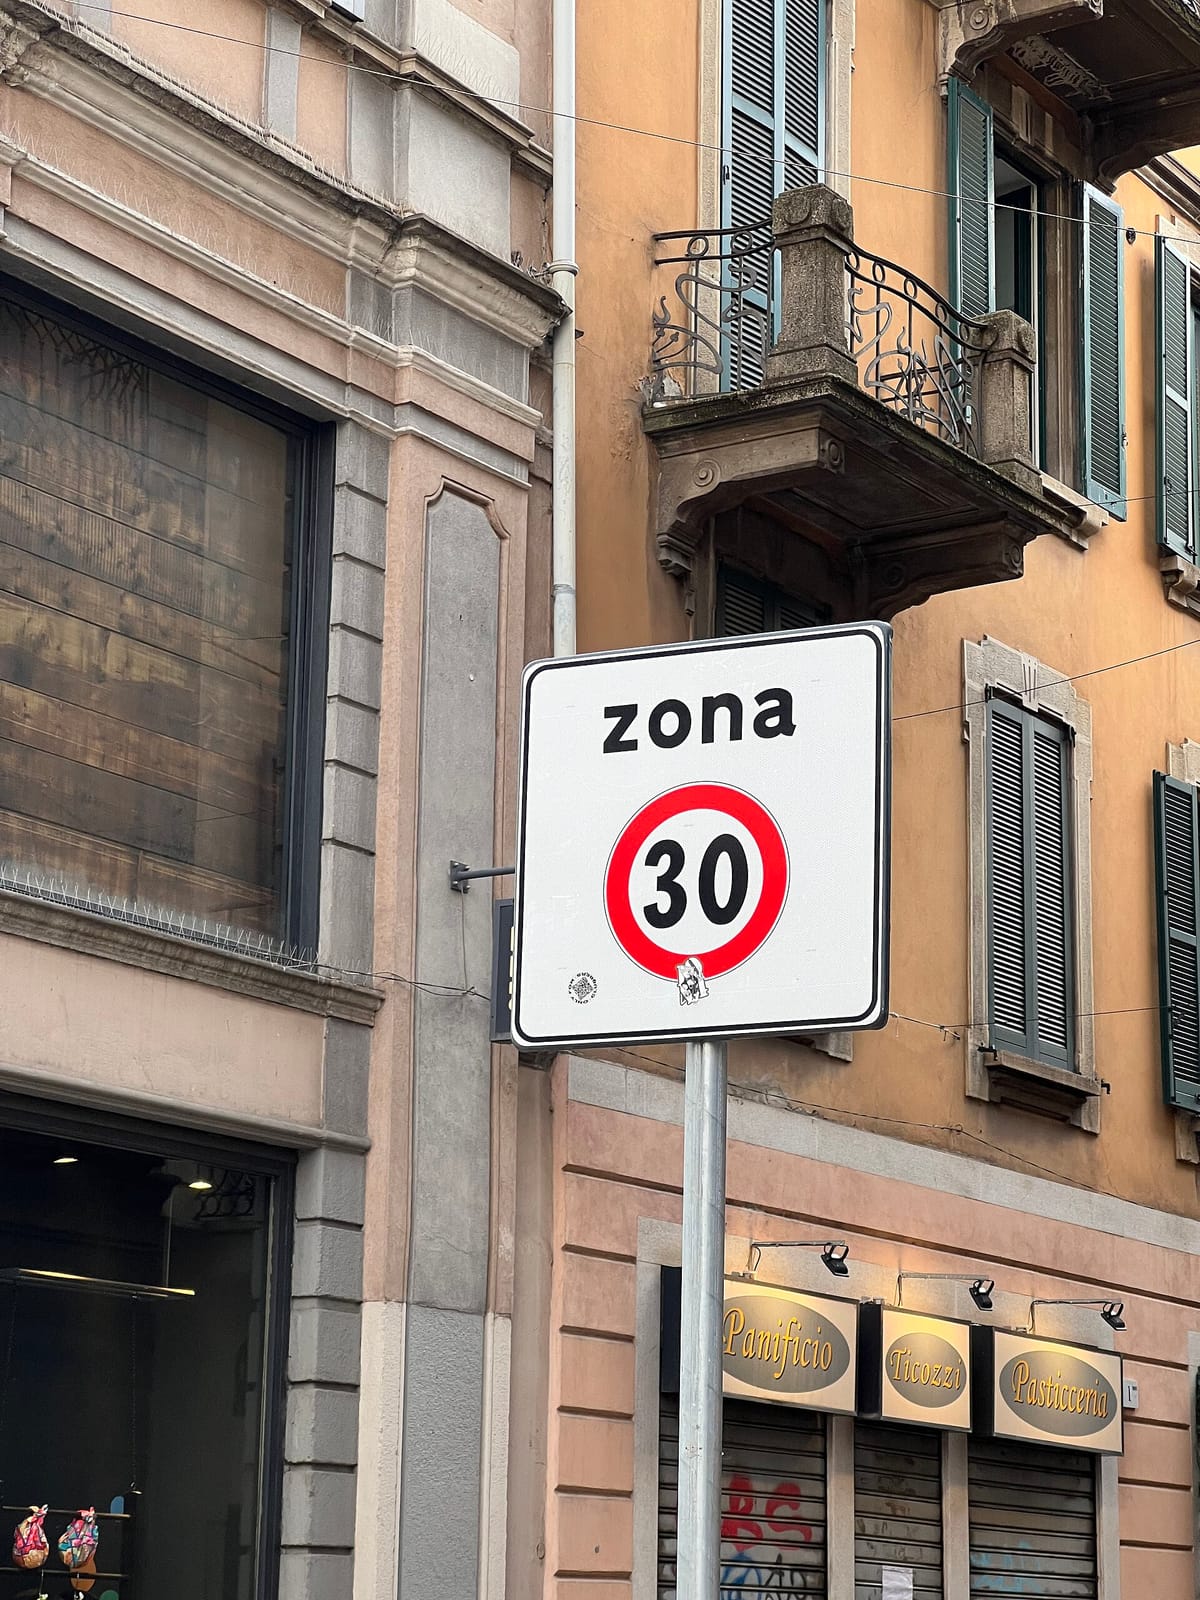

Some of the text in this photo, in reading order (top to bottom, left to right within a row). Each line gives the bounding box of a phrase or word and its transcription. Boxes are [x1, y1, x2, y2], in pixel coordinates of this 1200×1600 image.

[603, 687, 797, 754] zona
[643, 833, 749, 929] 30
[722, 1307, 833, 1380] Panificio
[890, 1346, 962, 1391] Ticozzi
[1011, 1360, 1109, 1419] Pasticceria
